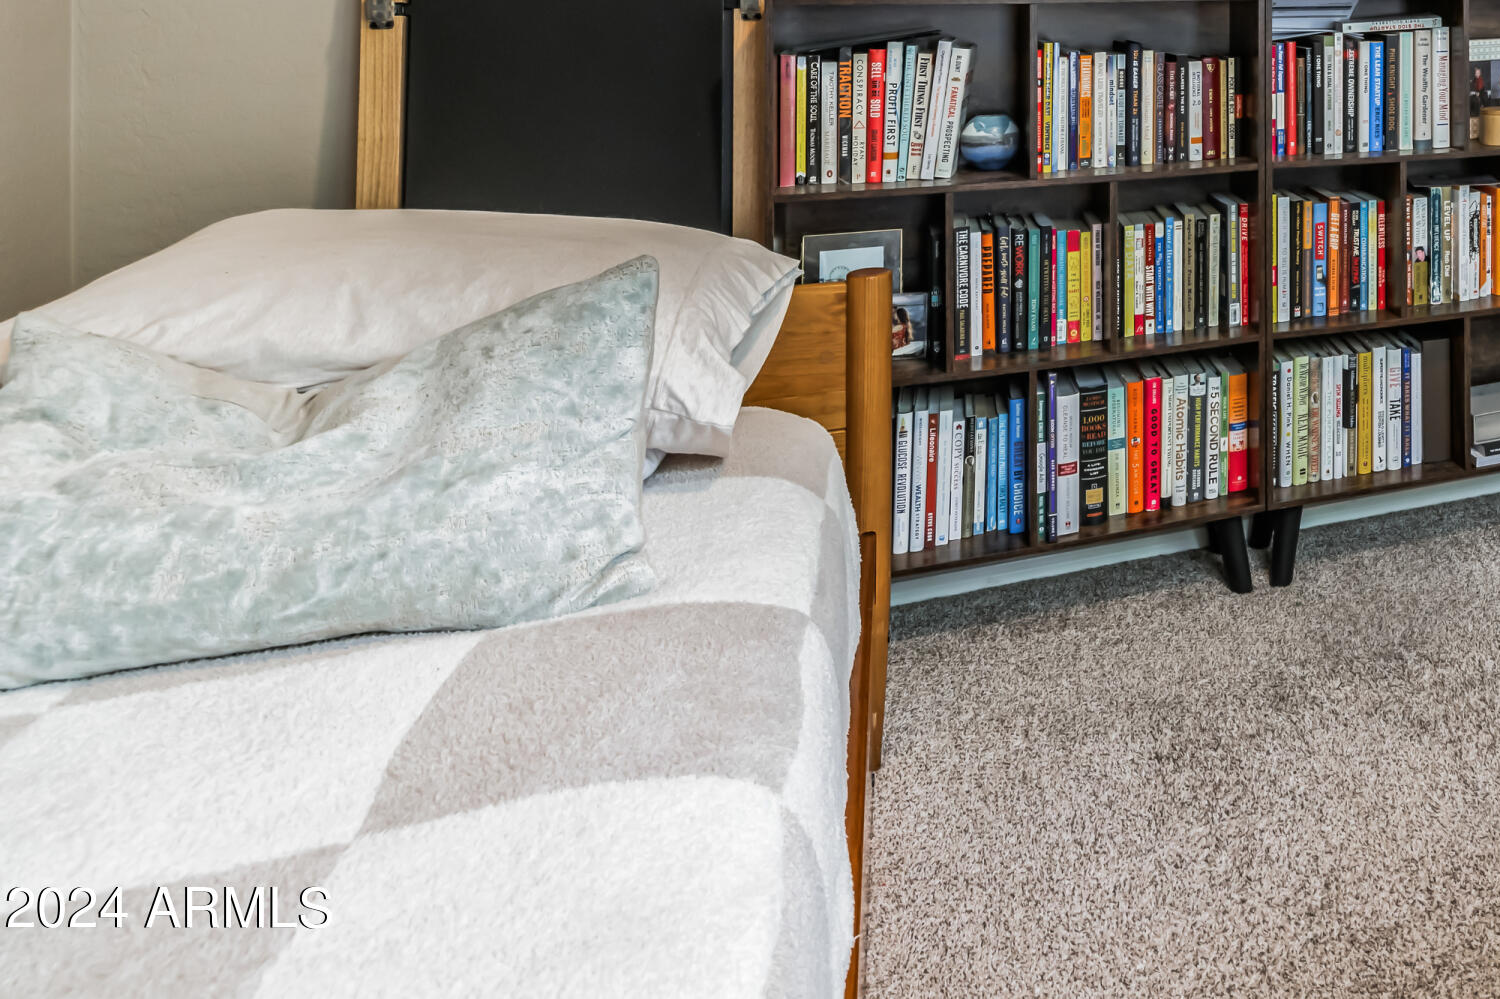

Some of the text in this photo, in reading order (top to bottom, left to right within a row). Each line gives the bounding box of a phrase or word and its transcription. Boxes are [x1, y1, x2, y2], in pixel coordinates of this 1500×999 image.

[954, 55, 962, 73] BLOUNT
[1388, 48, 1396, 89] PHIL KNIGHT
[1421, 67, 1429, 93] Wealthy
[810, 62, 818, 123] CARE OF THE SOUL
[839, 59, 852, 118] TRACTION
[856, 59, 864, 116] CONSPIRACY
[871, 62, 882, 118] SELL SOLD
[888, 83, 898, 116] PROFIT
[914, 57, 930, 128] FIRST THINGS FIRST
[1347, 78, 1355, 117] OWNERSHIP
[1437, 55, 1449, 121] Managing Your Mind
[941, 86, 958, 163] FANATICAL PROSPECTING
[1388, 97, 1396, 131] SHOE DOG
[886, 120, 897, 147] FIRST
[1331, 212, 1340, 225] GET
[1444, 229, 1451, 241] UP
[1014, 234, 1024, 276] REWORK
[1125, 230, 1134, 280] BIG DATA
[1329, 233, 1339, 250] GRIP
[959, 229, 969, 309] THE CARNIVORE CODE
[982, 246, 993, 294] PREPARED
[1145, 265, 1154, 285] START
[1145, 285, 1154, 301] WITH
[1145, 301, 1154, 317] WHY
[1361, 356, 1370, 396] multipliers
[1390, 367, 1401, 389] GIVE
[1083, 414, 1105, 424] 1,000
[1286, 402, 1291, 410] H.
[1390, 398, 1401, 421] TAKE
[929, 427, 937, 463] Lifeonaire
[1062, 434, 1068, 443] TO
[1082, 424, 1107, 432] BOOKS
[1087, 431, 1106, 440] READ
[1175, 397, 1186, 481] Atomic Habits
[1208, 391, 1220, 485] 5 SECOND RULE
[1297, 413, 1307, 459] REAL MAGIC
[953, 432, 963, 460] COPY
[1151, 443, 1158, 456] TO
[1311, 419, 1319, 474] WAYNE W DYER
[896, 440, 908, 514] GLUCOSE REVOLUTION
[1013, 470, 1024, 481] BY
[1013, 482, 1024, 516] CHOICE
